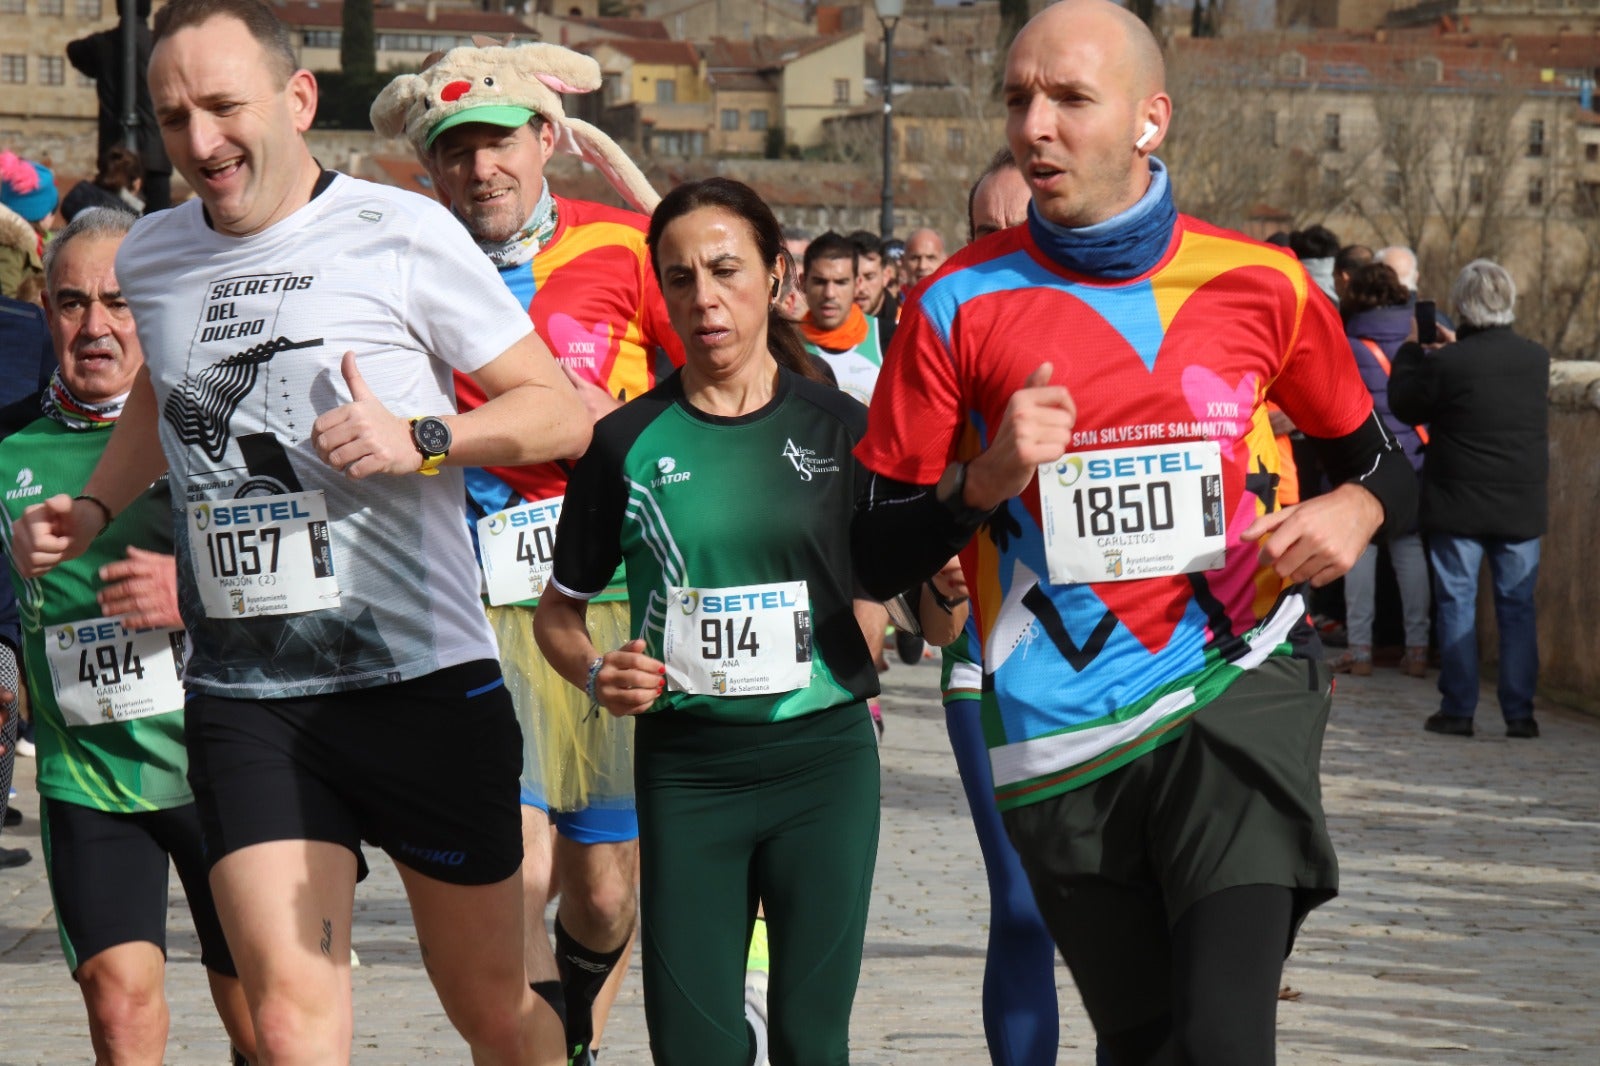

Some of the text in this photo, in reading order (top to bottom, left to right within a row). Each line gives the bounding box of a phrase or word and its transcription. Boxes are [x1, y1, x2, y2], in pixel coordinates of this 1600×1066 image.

[210, 276, 314, 301] SECRETOS
[206, 302, 238, 323] DEL
[200, 319, 265, 343] DUERO
[568, 342, 596, 354] XXXIX
[1206, 402, 1238, 417] XXXIX
[1073, 431, 1098, 447] SAN
[1100, 423, 1165, 444] SILVESTRE
[1088, 451, 1203, 480] SETEL
[650, 471, 691, 489] VIATOR
[6, 484, 43, 501] VIATOR
[213, 500, 310, 526] SETEL
[510, 503, 563, 527] SET
[1073, 481, 1174, 538] 1850
[516, 526, 559, 566] 40
[1097, 533, 1156, 548] CARLITOS
[207, 527, 281, 578] 1057
[1126, 554, 1174, 566] Ayuntamiento
[1136, 563, 1175, 573] Salamanca
[219, 574, 276, 588] MANJÓN (2)
[255, 603, 288, 612] Salamanca
[702, 591, 796, 613] SETEL
[701, 616, 760, 659] 914
[79, 641, 145, 687] 494
[721, 659, 741, 669] ANA
[729, 676, 770, 685] Ayuntamiento
[738, 684, 770, 692] Salamanca
[96, 684, 131, 697] GABINO
